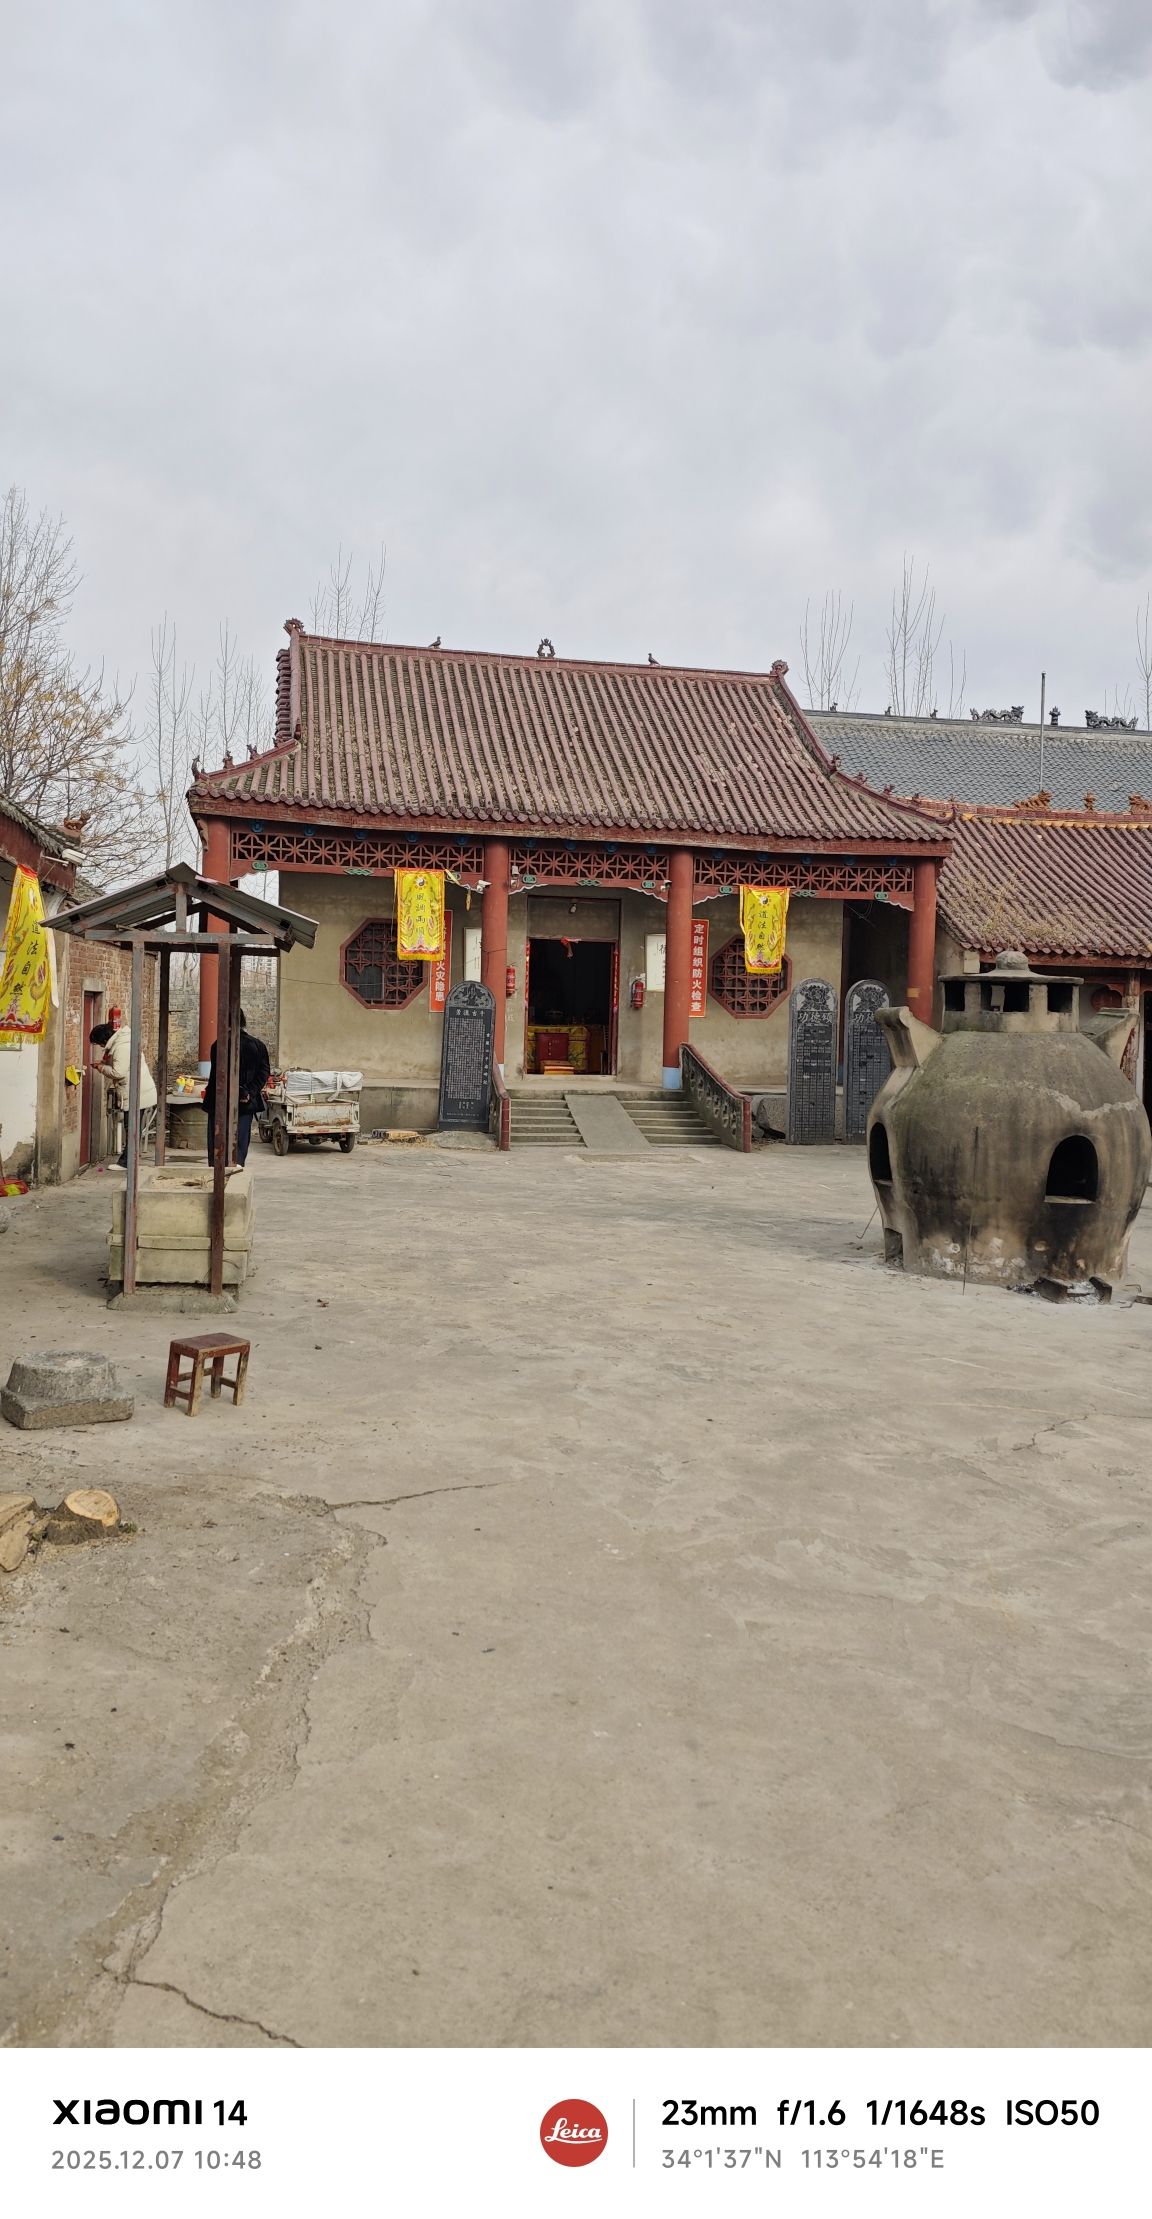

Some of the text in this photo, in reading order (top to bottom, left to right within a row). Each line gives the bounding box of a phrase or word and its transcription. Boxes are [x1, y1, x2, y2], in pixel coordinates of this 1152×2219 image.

[755, 910, 769, 950] 道法自然
[690, 923, 705, 1012] 定时组织防火检查
